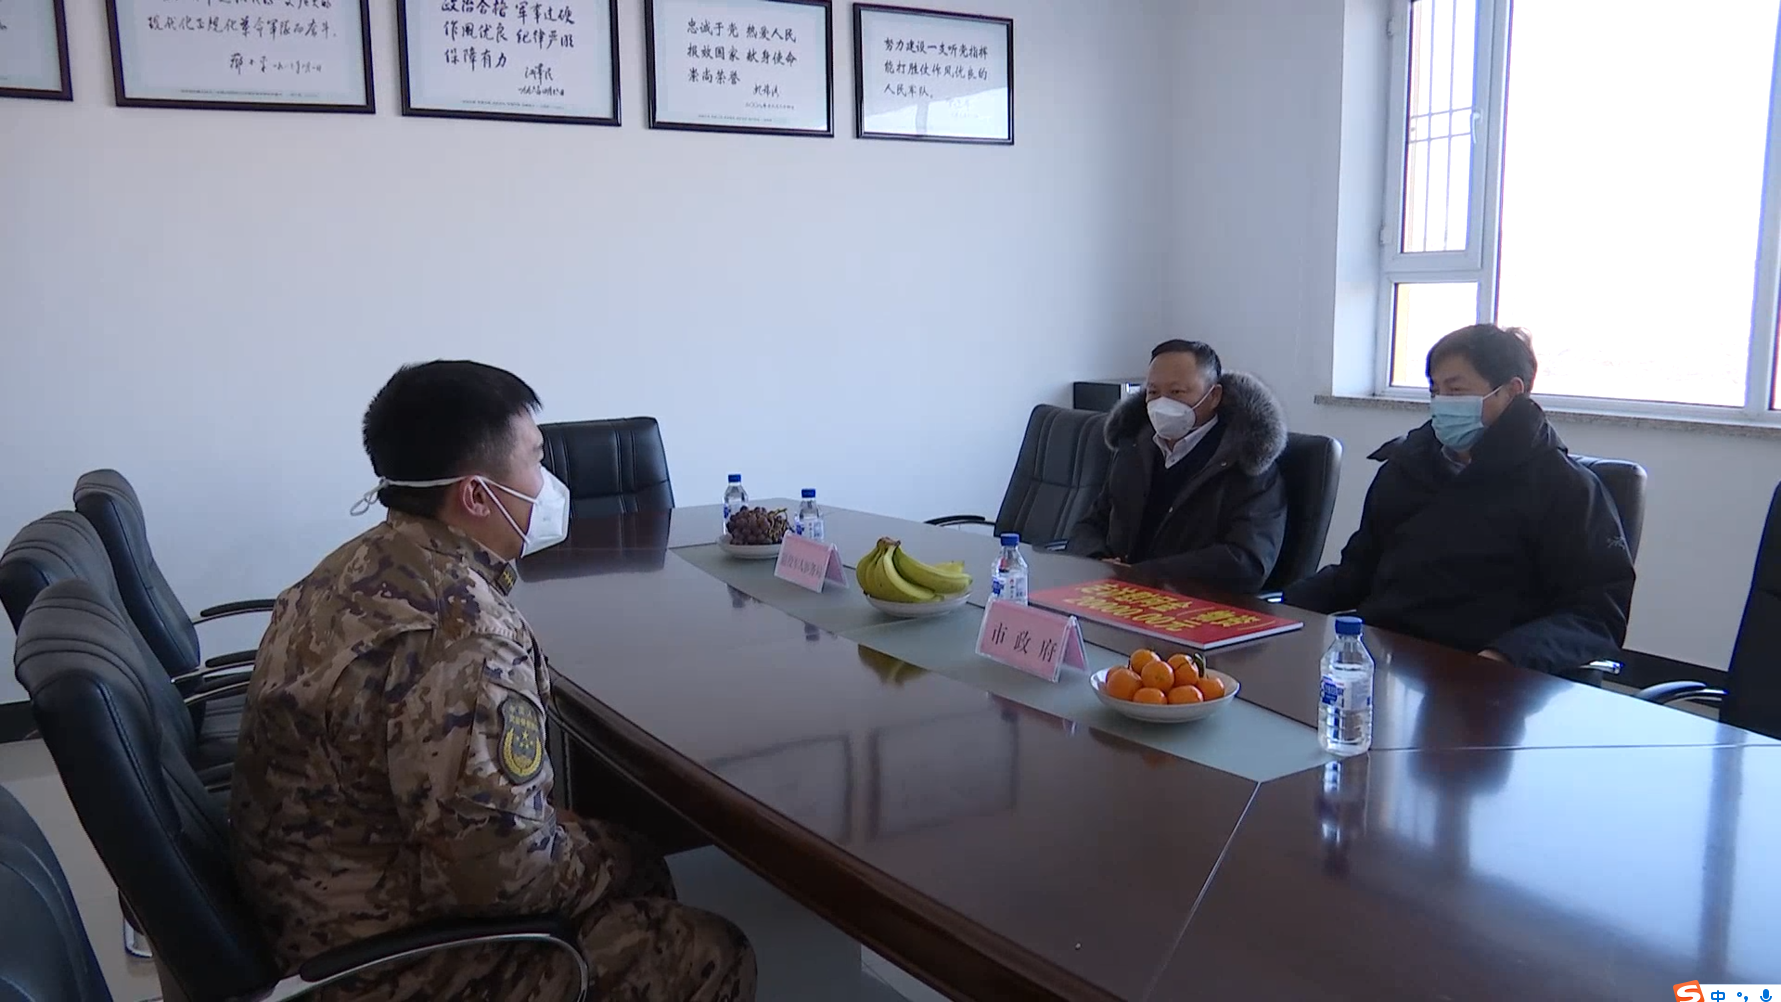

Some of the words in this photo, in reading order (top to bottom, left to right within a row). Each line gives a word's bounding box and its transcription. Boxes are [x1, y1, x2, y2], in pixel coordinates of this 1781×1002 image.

[687, 17, 739, 38] 忠诚于党
[746, 23, 797, 43] 热爱人民
[444, 48, 507, 71] 保障有力
[687, 43, 740, 62] 报效国家
[992, 622, 1057, 662] 市政府
